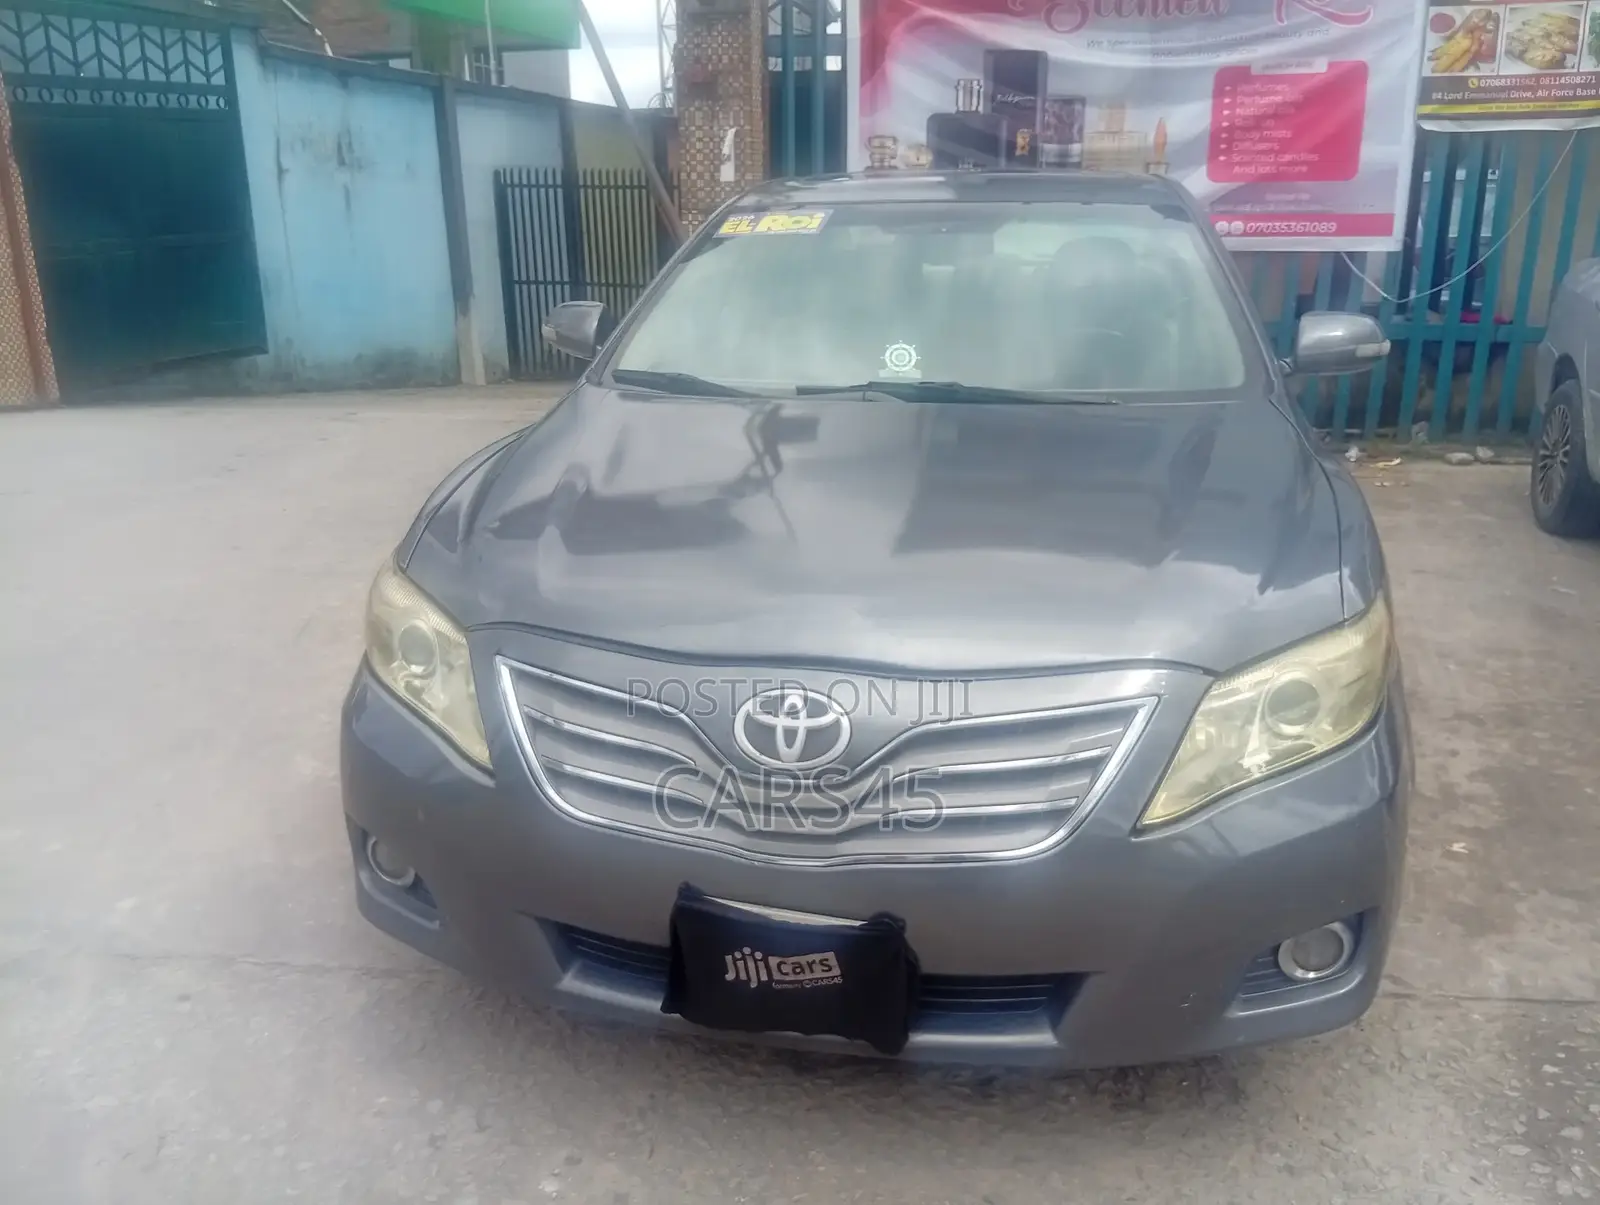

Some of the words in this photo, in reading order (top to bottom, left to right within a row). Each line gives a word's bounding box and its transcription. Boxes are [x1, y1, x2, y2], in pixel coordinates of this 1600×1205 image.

[1510, 90, 1535, 99] Drive,
[1551, 89, 1574, 97] Force
[1576, 87, 1597, 96] Base
[776, 956, 833, 977] cars
